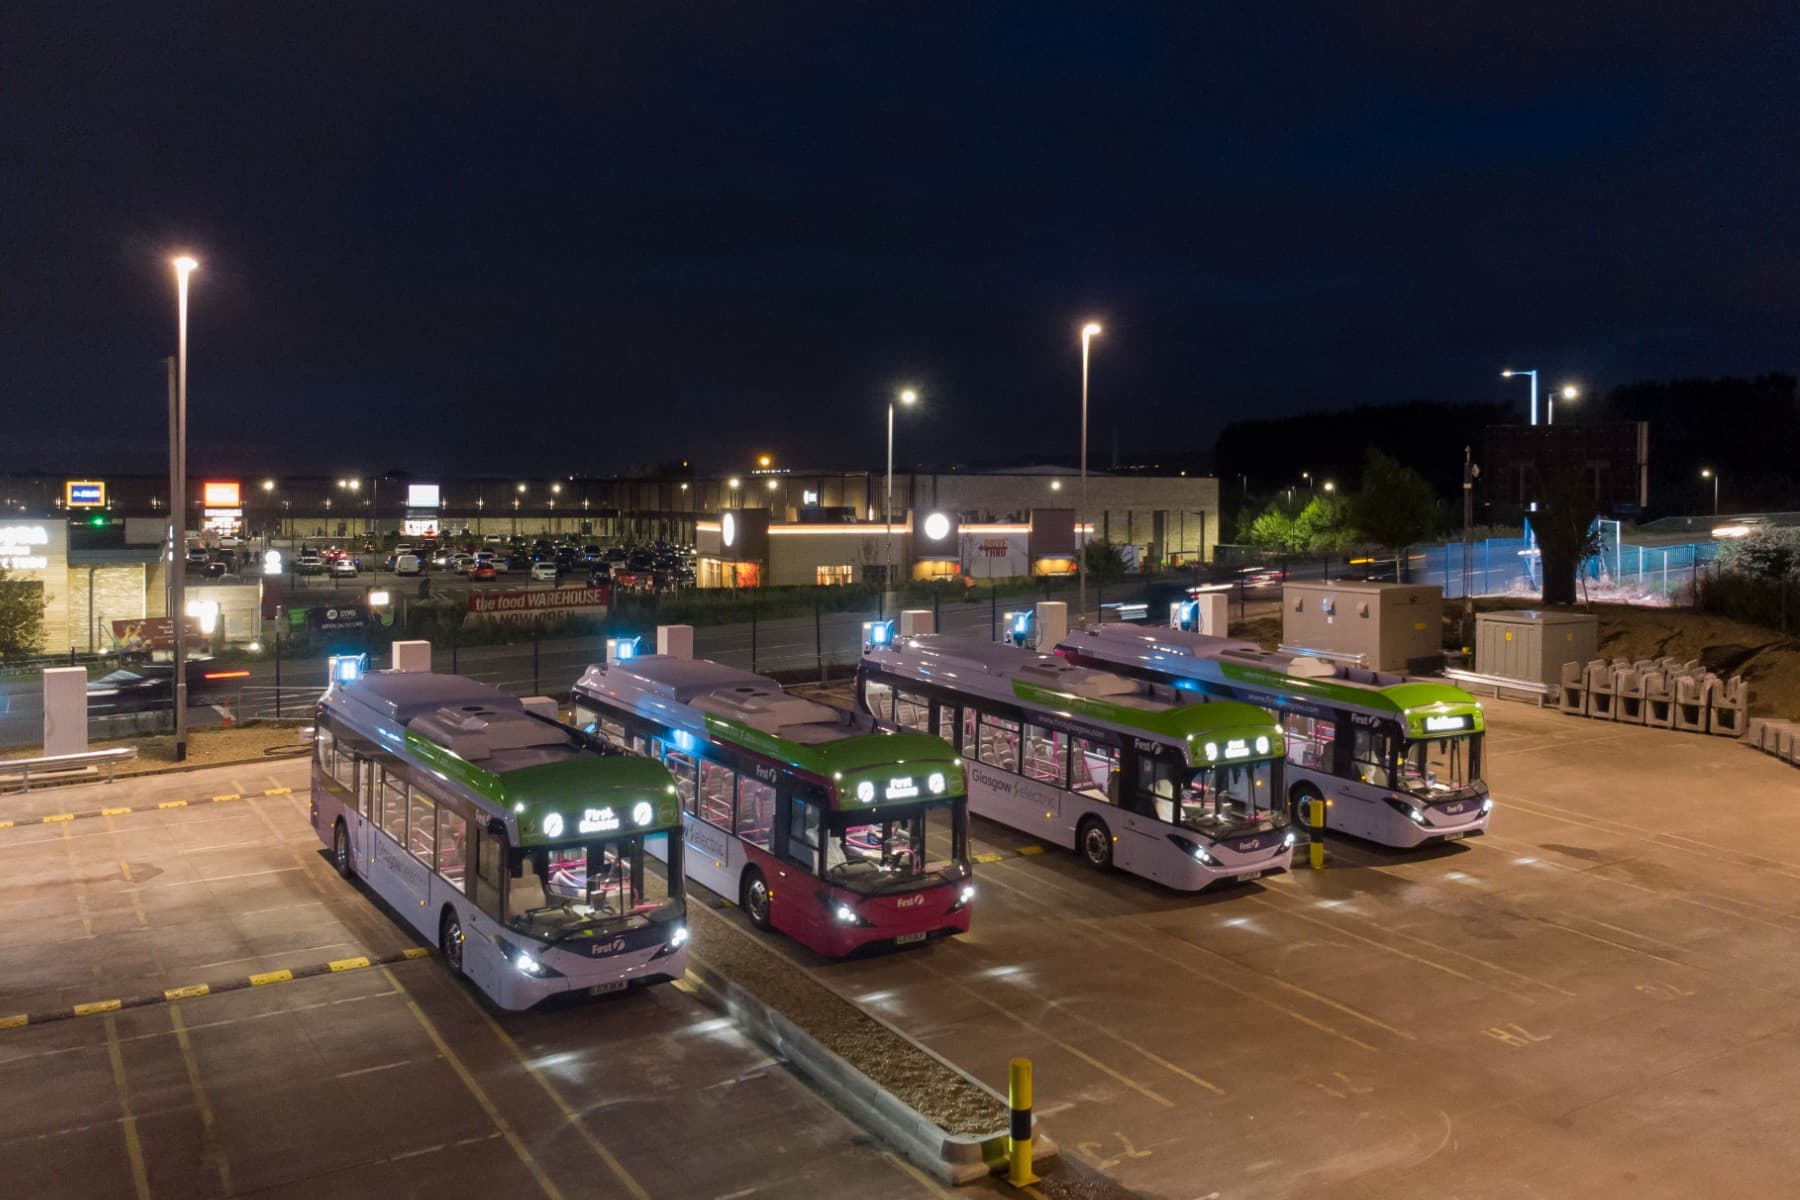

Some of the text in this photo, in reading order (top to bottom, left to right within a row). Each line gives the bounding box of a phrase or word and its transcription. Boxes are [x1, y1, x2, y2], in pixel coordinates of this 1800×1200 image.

[475, 588, 602, 611] the food WAREHOUSE
[1134, 737, 1152, 752] First
[755, 764, 769, 779] First
[971, 768, 1056, 808] Glasgow electric
[584, 807, 614, 822] First
[897, 897, 914, 909] First
[592, 942, 612, 955] First
